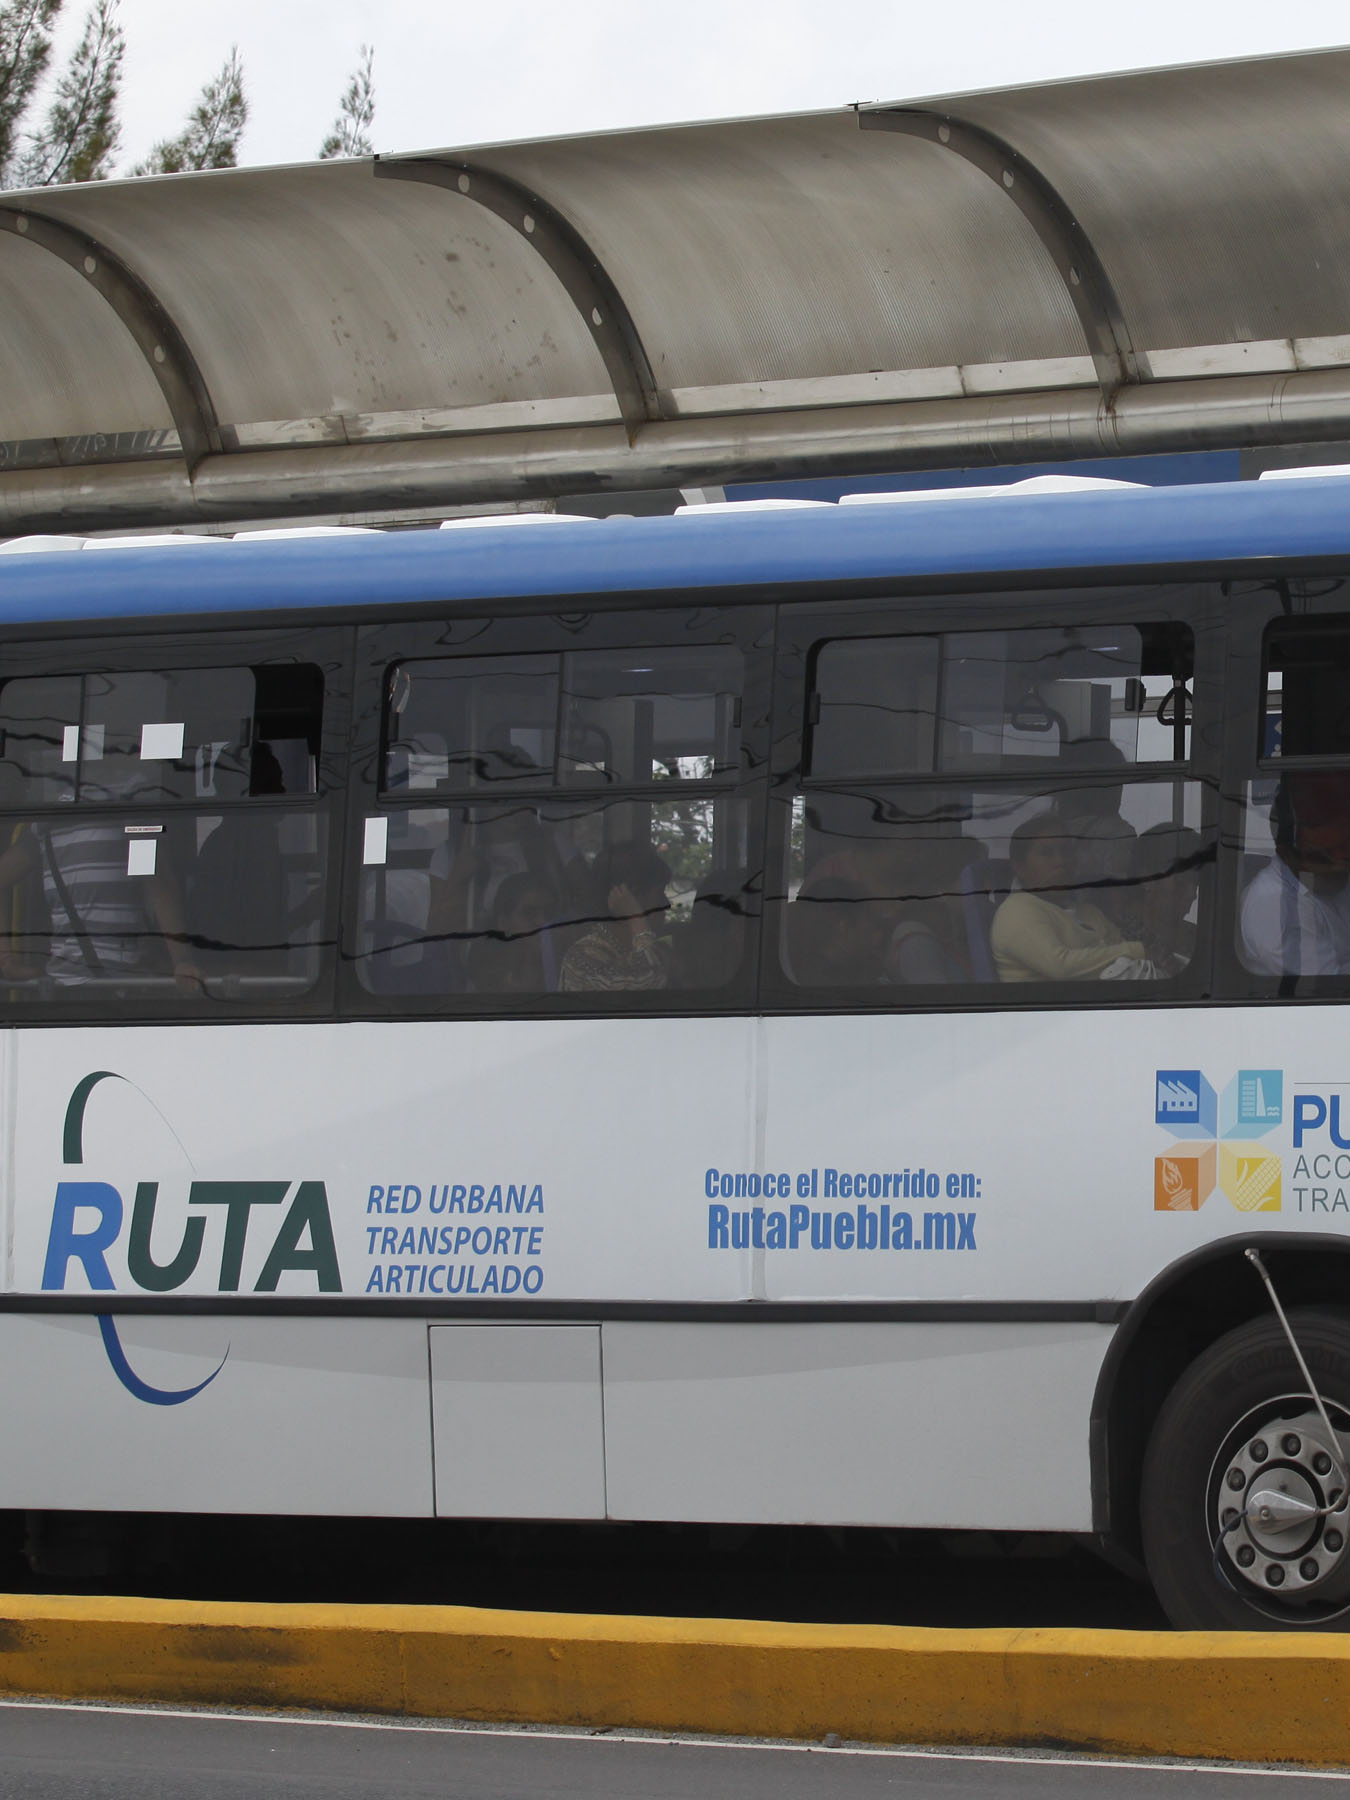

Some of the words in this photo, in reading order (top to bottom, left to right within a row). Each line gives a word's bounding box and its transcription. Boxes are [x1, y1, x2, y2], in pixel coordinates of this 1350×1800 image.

[366, 1184, 422, 1214] RED
[428, 1184, 545, 1214] URBANA
[704, 1168, 791, 1199] Conoce
[796, 1168, 818, 1199] el
[823, 1168, 940, 1199] Recorrido
[945, 1172, 982, 1199] en:
[41, 1180, 344, 1293] RUTA
[365, 1225, 545, 1256] TRANSPORTE
[707, 1203, 978, 1251] RutaPuebla.mx
[364, 1264, 545, 1295] ARTICULADO
